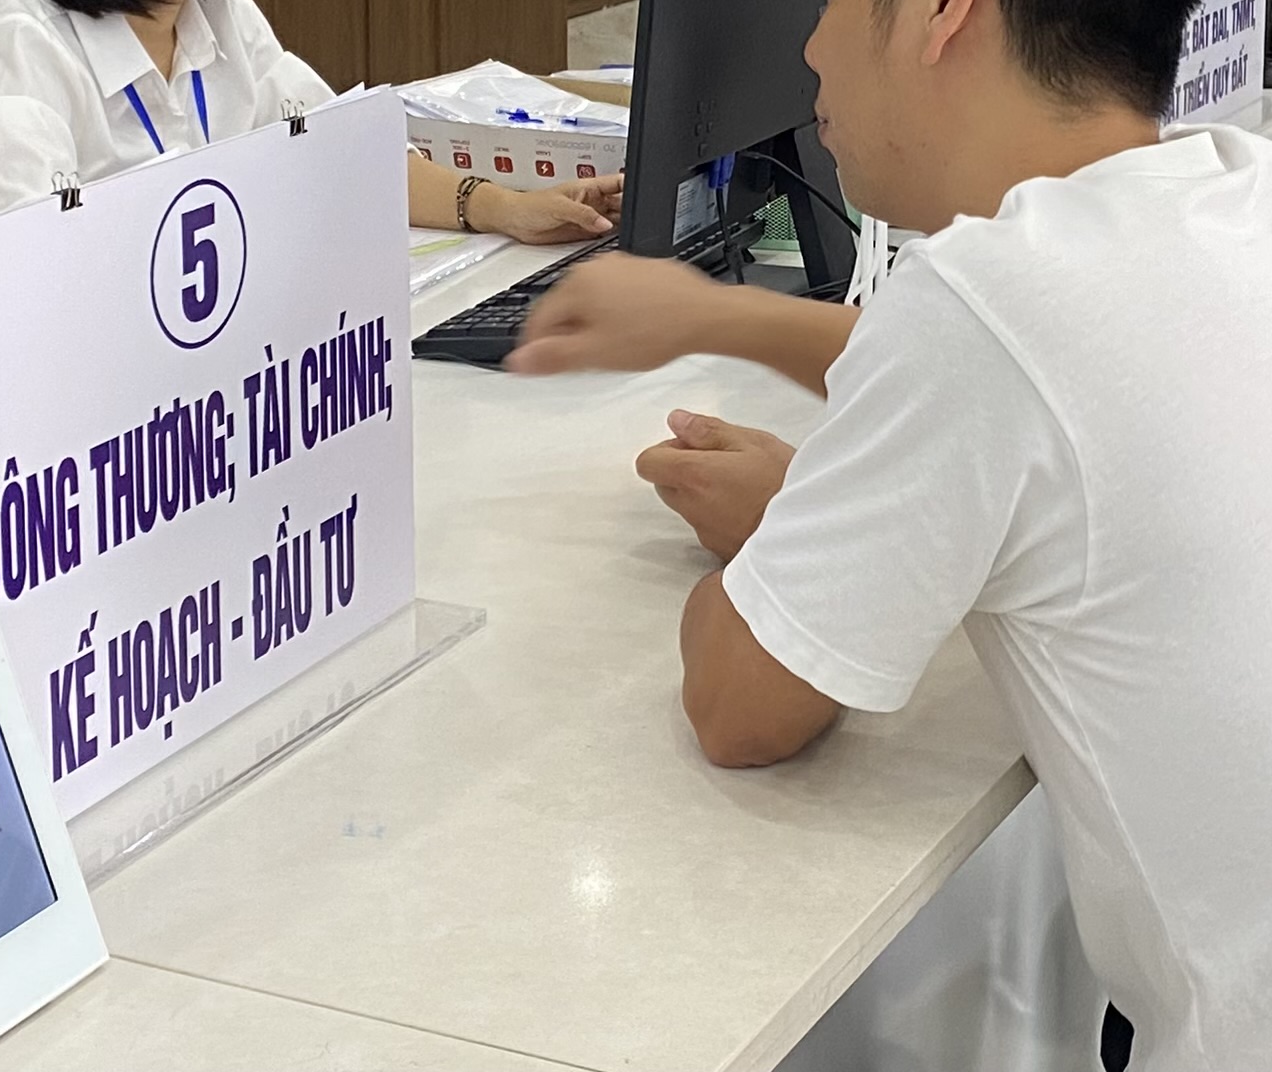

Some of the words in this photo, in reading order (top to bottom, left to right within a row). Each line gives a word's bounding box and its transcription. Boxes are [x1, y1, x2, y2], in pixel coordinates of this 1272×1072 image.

[1183, 61, 1210, 116] TRIỂN
[1231, 44, 1248, 92] ĐẤT
[1192, 3, 1210, 53] ĐẤT
[180, 202, 220, 323] 5
[90, 390, 235, 555] THƯƠNG;
[243, 344, 291, 478] TÀI
[299, 311, 392, 451] CHÍNH;
[50, 609, 98, 783] KẾ
[108, 580, 222, 748] HOẠCH
[252, 505, 312, 661] ĐẦU
[320, 493, 357, 617] TƯ
